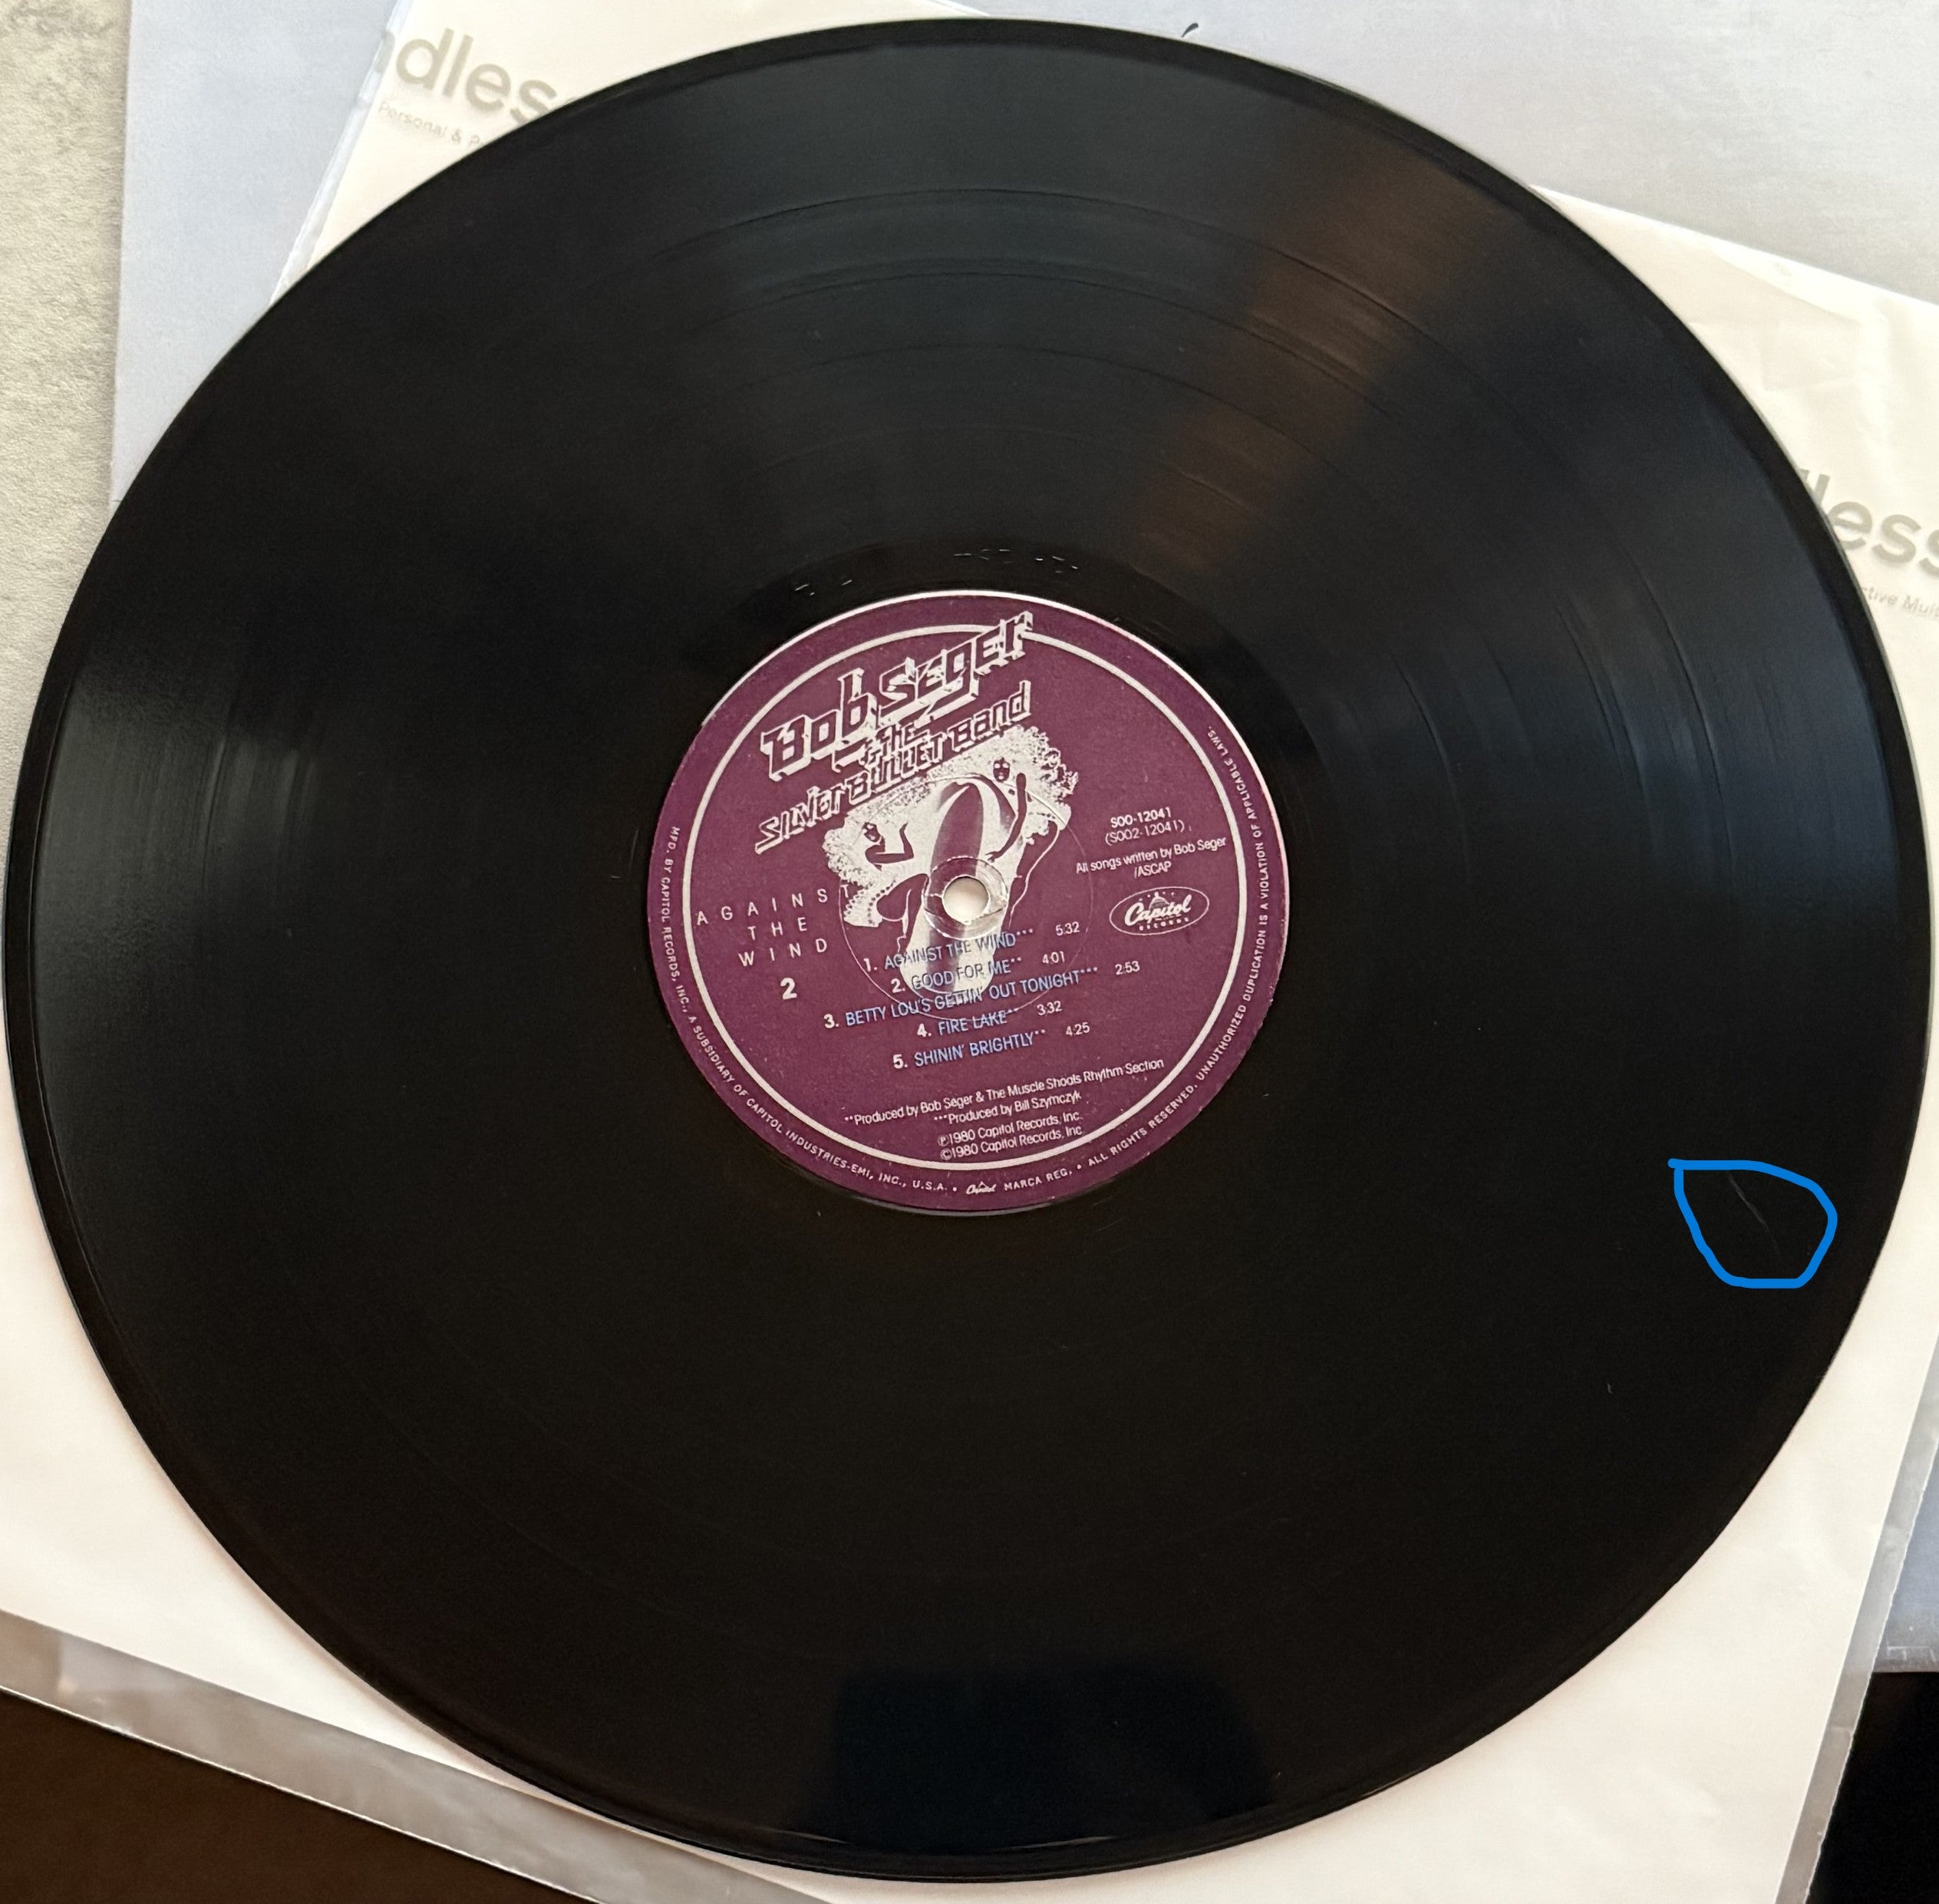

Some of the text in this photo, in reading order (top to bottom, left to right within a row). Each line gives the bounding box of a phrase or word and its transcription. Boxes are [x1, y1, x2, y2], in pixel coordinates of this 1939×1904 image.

[375, 28, 577, 124] dles
[378, 101, 450, 138] Personal
[1862, 585, 1899, 609] tive
[760, 668, 878, 781] Bob
[1207, 725, 1229, 757] LAWS.
[1224, 757, 1258, 820] APPLICABLE
[666, 826, 681, 853] MFD.
[1250, 824, 1262, 838] OF
[663, 858, 674, 873] BY
[1076, 837, 1226, 874] All songs written by Bob Seger
[1134, 860, 1172, 878] /ASCAP
[1255, 843, 1269, 900] VIOLATION
[661, 876, 671, 922] CAPITOL
[697, 884, 850, 926] AGAINST
[1124, 893, 1192, 926] Capitol
[747, 917, 808, 941] THE
[1258, 914, 1268, 926] IS
[662, 926, 681, 982] RECORDS,
[738, 939, 828, 967] WIND
[863, 958, 878, 972] 1.
[885, 946, 942, 970] AGAINST
[946, 940, 971, 959] THE
[1055, 921, 1080, 936] 5:32
[891, 978, 906, 993] 2.
[912, 970, 955, 990] GOOD
[956, 963, 984, 980] FOR
[1042, 951, 1066, 965] 4:01
[1242, 930, 1267, 1002] DUPLICATION
[675, 985, 690, 1013] INC.,
[780, 977, 798, 1000] 2
[824, 1014, 839, 1028] 3.
[846, 1005, 886, 1026] BETTY
[891, 998, 932, 1018] LOU'S
[989, 981, 1017, 999] OUT
[1115, 961, 1140, 975] 2:53
[688, 1015, 697, 1024] A
[917, 1023, 932, 1038] 4.
[938, 1018, 969, 1036] FIRE
[1037, 1000, 1063, 1016] 3:32
[693, 1025, 734, 1084] SUBSIDIARY
[893, 1054, 908, 1069] 5.
[915, 1044, 965, 1067] SHININ'
[1065, 1021, 1091, 1036] 4:25
[1195, 1005, 1247, 1081] UNAUTHORIZED
[734, 1084, 749, 1097] OF
[906, 1105, 919, 1117] by
[920, 1100, 942, 1114] Bob
[943, 1095, 974, 1110] Seger
[975, 1091, 985, 1102] &
[986, 1087, 1006, 1101] The
[1007, 1081, 1045, 1097] Muscle
[1046, 1074, 1082, 1090] Shoals
[1083, 1066, 1124, 1083] Rhythm
[1125, 1059, 1165, 1074] Section
[999, 1104, 1013, 1116] by
[1014, 1099, 1031, 1113] Bill
[1032, 1090, 1082, 1110] Szymczyk
[746, 1098, 783, 1134] CAPITOL
[1149, 1084, 1199, 1130] RESERVED.
[978, 1121, 1015, 1139] Capitol
[1016, 1114, 1062, 1131] Records,
[981, 1137, 1017, 1153] Capitol
[1020, 1129, 1065, 1147] Records,
[1110, 1127, 1148, 1157] RIGHTS
[786, 1130, 875, 1180] INDUSTRIES-EMI,
[1087, 1153, 1110, 1167] ALL
[878, 1173, 907, 1188] INC.,
[912, 1180, 948, 1191] U.S.A.
[1004, 1176, 1043, 1191] MARCA
